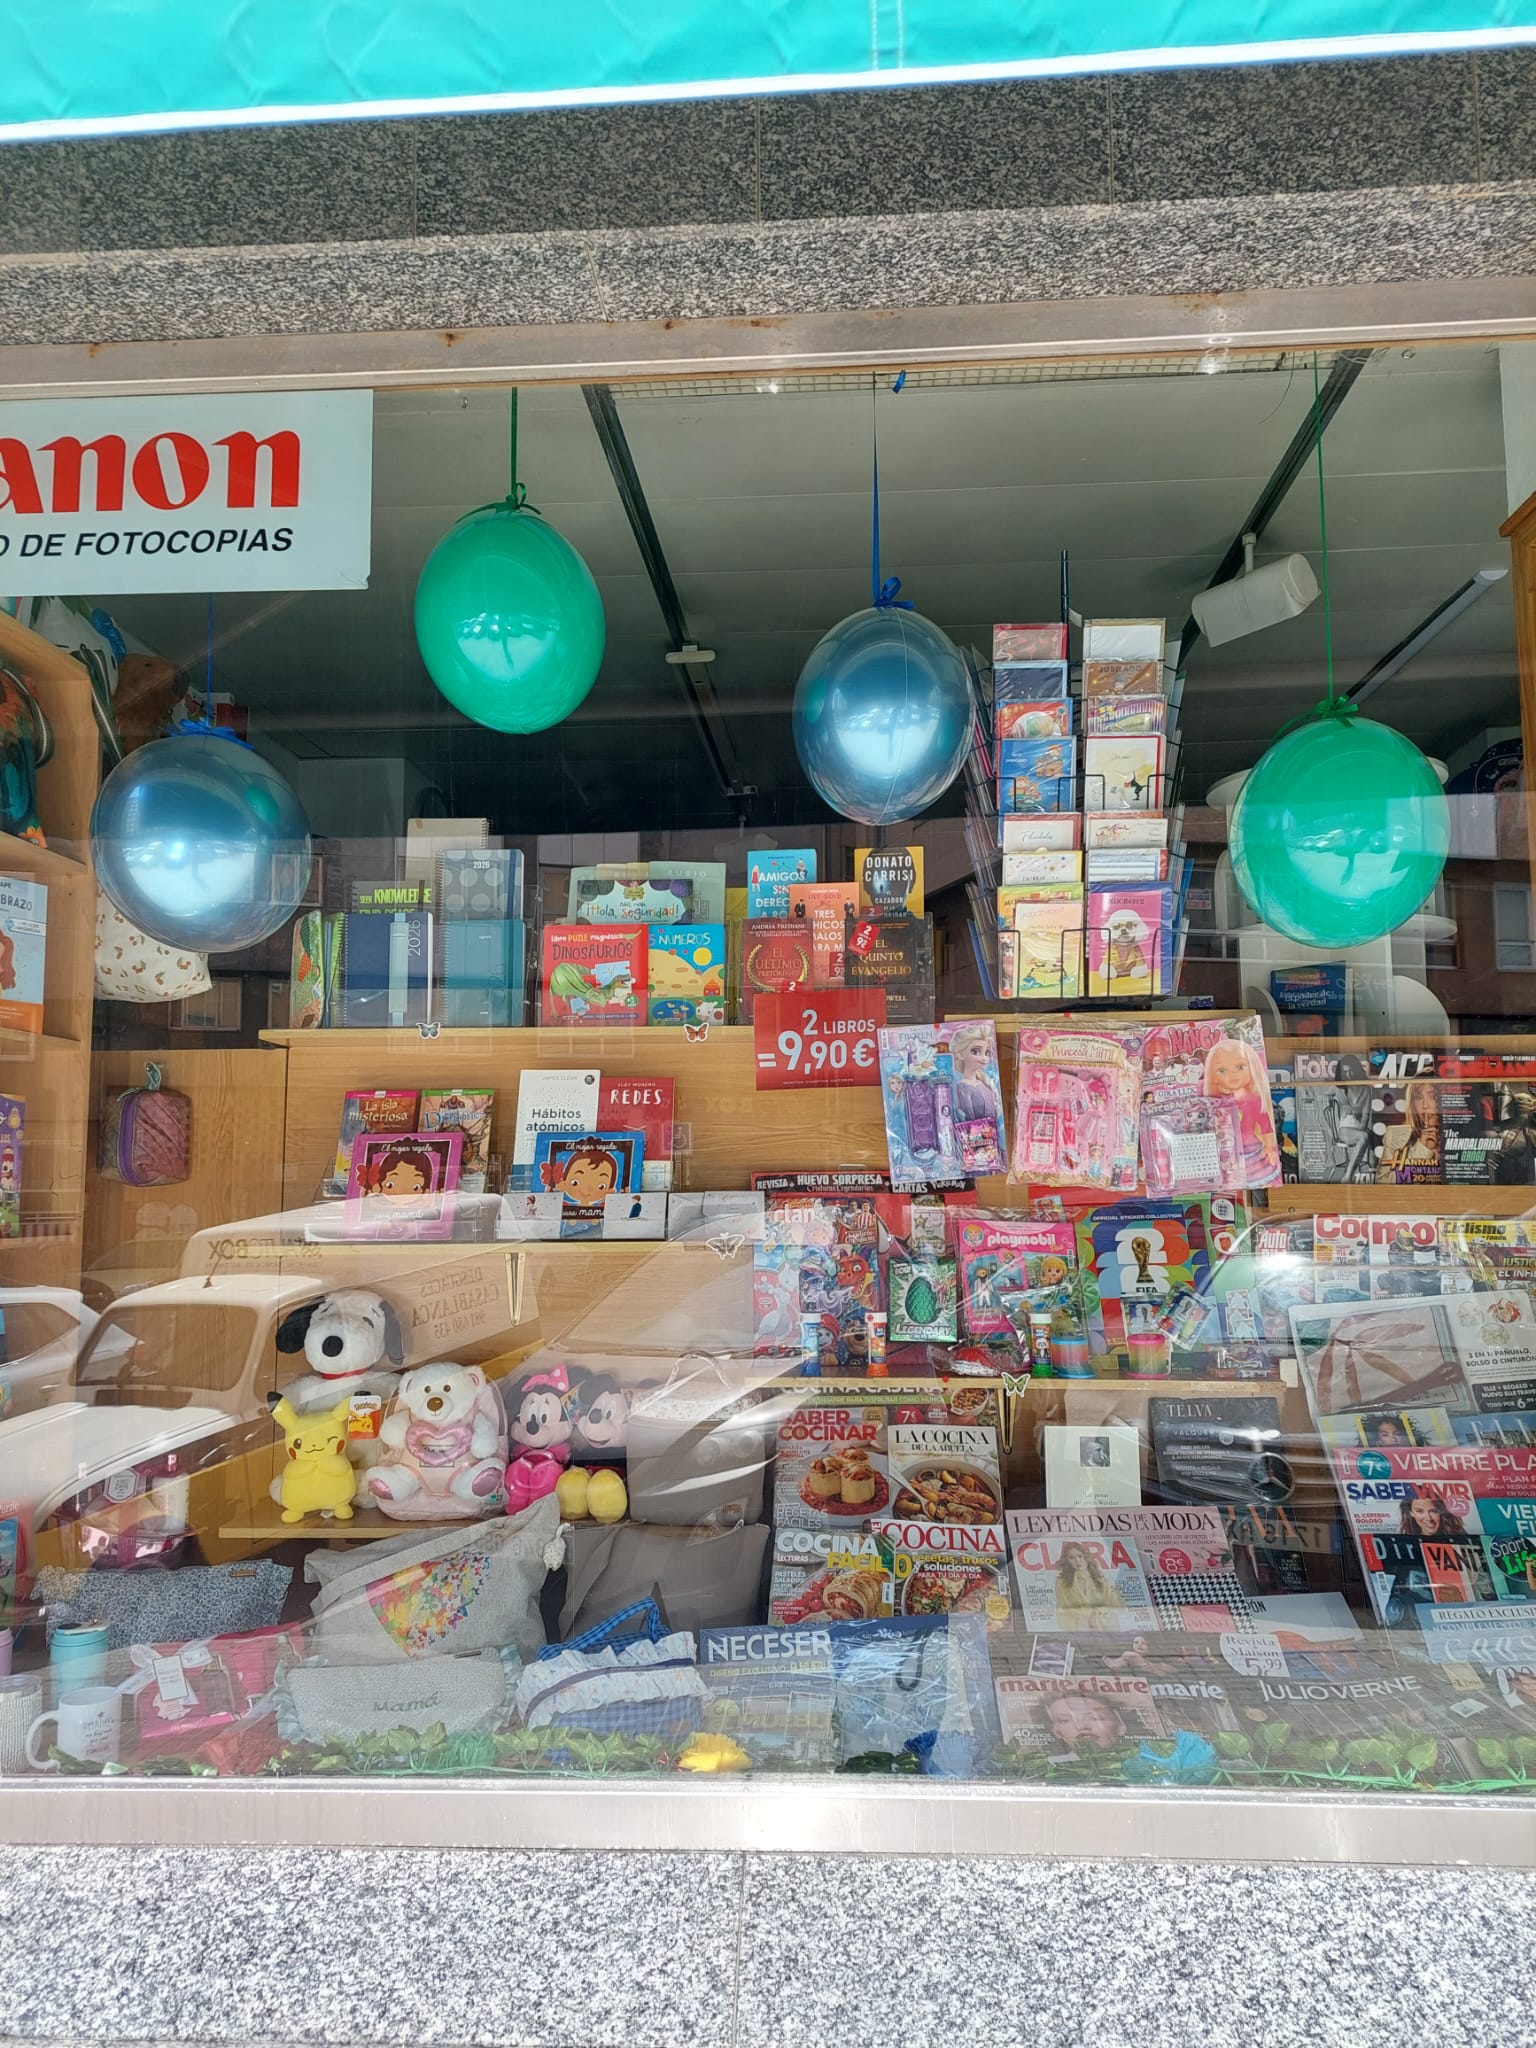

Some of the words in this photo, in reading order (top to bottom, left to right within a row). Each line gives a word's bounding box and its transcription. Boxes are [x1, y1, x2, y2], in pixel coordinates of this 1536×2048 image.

[20, 533, 66, 557] DE
[75, 527, 294, 556] FOTOCOPIAS
[866, 856, 912, 868] DONATO
[758, 871, 806, 882] AMIGOS
[864, 869, 914, 882] CARRISI
[374, 888, 432, 904] KNOWLEDE
[621, 905, 679, 920] seguridad!
[814, 909, 836, 919] TRES
[863, 925, 872, 935] 2
[408, 920, 421, 957] 2026
[875, 939, 888, 948] EL
[552, 942, 633, 960] DINOSAURIOS
[859, 952, 905, 963] QUINTO
[851, 965, 912, 975] EVANGELIO
[789, 982, 797, 991] 2
[802, 1009, 818, 1036] 2
[823, 1019, 876, 1035] LIBROS
[611, 1089, 663, 1105] REDES
[366, 1102, 378, 1111] La
[381, 1099, 398, 1110] isla
[348, 1111, 408, 1122] misteriosa
[532, 1108, 582, 1119] Hábitos
[526, 1121, 585, 1132] atómicos
[1443, 1129, 1459, 1137] The
[1445, 1138, 1503, 1150] MANDALORIAN
[757, 1178, 789, 1190] REVISTA
[797, 1175, 828, 1186] HUEVO
[833, 1174, 883, 1185] SORPRESA
[892, 1183, 928, 1193] CARTAS
[774, 1203, 815, 1224] clan
[1372, 1217, 1444, 1245] mo
[1442, 1221, 1506, 1235] Ciclismo
[987, 1231, 1056, 1247] playmobil
[1260, 1231, 1287, 1249] Auto
[1498, 1270, 1511, 1278] EL
[895, 1323, 953, 1336] LEGENDARY
[1466, 1359, 1490, 1367] BOLSO
[1517, 1398, 1526, 1409] 6
[1167, 1404, 1213, 1417] TELVA
[781, 1410, 850, 1425] SABER
[778, 1424, 876, 1441] COCINAR
[895, 1430, 918, 1444] LA
[921, 1430, 990, 1445] COCINA
[939, 1444, 974, 1452] ABUELA
[1394, 1453, 1492, 1471] VIENTRE
[776, 1508, 828, 1519] RECETAS
[1014, 1514, 1132, 1533] LEYENDAS
[1134, 1514, 1148, 1523] DE
[1151, 1512, 1217, 1531] MODA
[777, 1532, 879, 1556] COCINA
[882, 1522, 1004, 1553] COCINA
[1490, 1537, 1529, 1558] Sport
[777, 1553, 809, 1562] LECTURAS
[1017, 1540, 1137, 1572] CLRA
[914, 1564, 922, 1573] y
[924, 1563, 982, 1573] soluciones
[1439, 1609, 1486, 1620] REGALO
[707, 1631, 832, 1663] NECESER
[1226, 1635, 1276, 1646] Revista
[1230, 1646, 1279, 1658] Maison
[1000, 1677, 1075, 1693] marie
[1078, 1676, 1148, 1693] claire
[1151, 1680, 1224, 1698] marie
[1259, 1680, 1329, 1701] JULIO
[1330, 1676, 1421, 1699] VERNE
